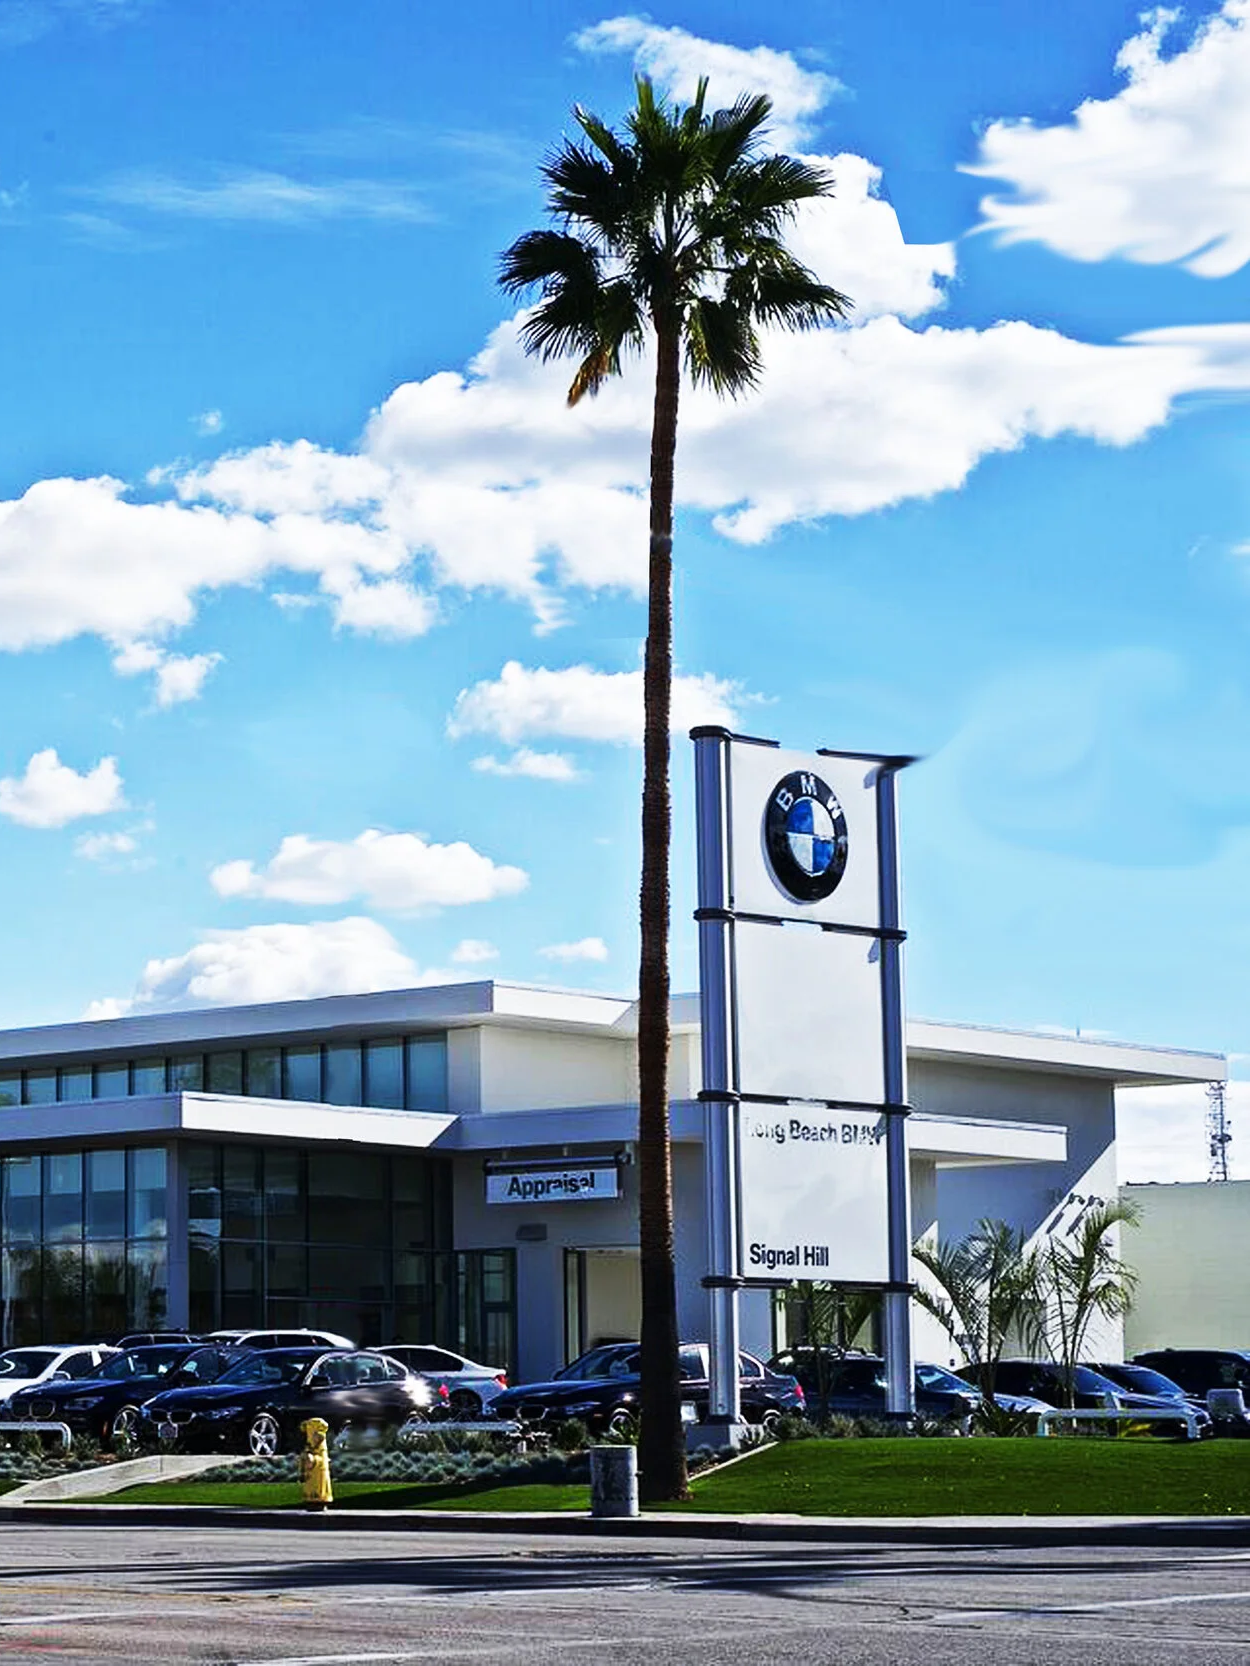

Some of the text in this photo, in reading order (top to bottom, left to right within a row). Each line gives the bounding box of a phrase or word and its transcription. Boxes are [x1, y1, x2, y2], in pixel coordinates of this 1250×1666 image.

[776, 773, 845, 819] BMW
[789, 1119, 838, 1142] Beach
[507, 1171, 596, 1199] Appraisal
[749, 1243, 829, 1270] Signal Hill
